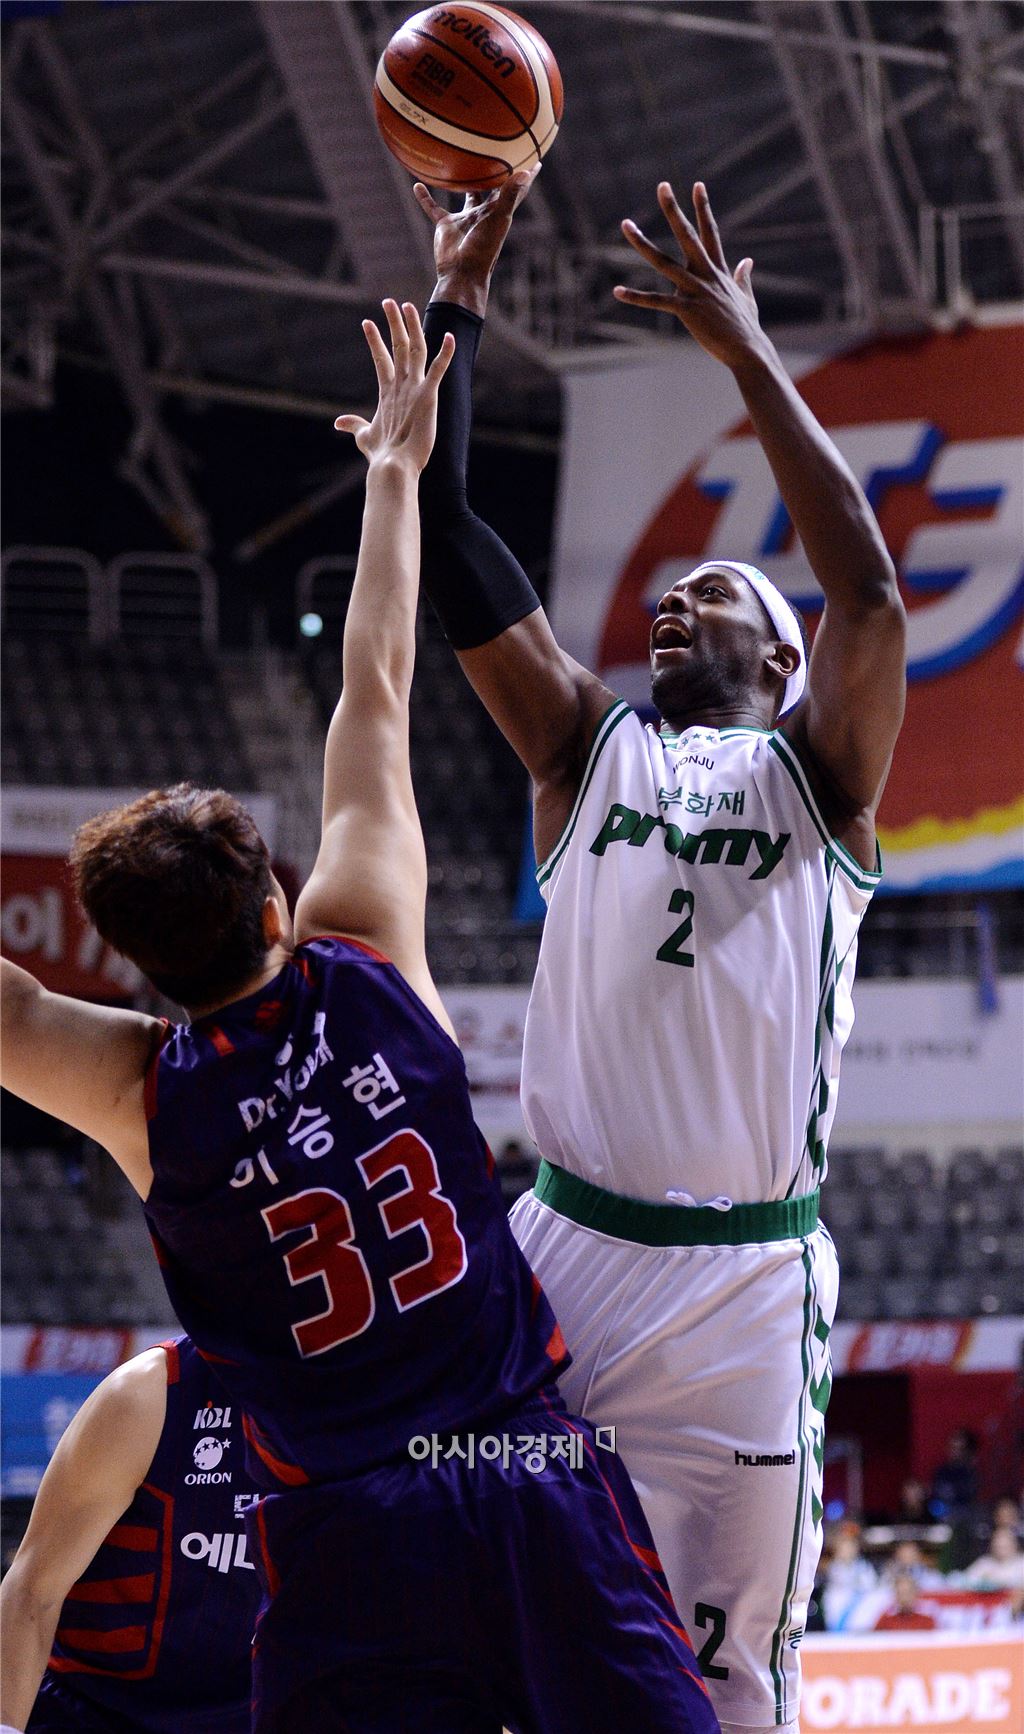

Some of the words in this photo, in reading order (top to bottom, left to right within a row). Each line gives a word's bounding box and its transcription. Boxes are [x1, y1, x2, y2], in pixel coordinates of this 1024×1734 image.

[416, 53, 456, 88] FIBA
[433, 11, 516, 79] molten
[588, 802, 791, 880] promy
[656, 888, 695, 968] 2
[260, 1127, 468, 1360] 33
[193, 1406, 232, 1430] KBL
[184, 1472, 232, 1486] ORION
[734, 1450, 796, 1467] hummel
[694, 1602, 729, 1681] 2
[801, 1668, 1011, 1728] ORADE
